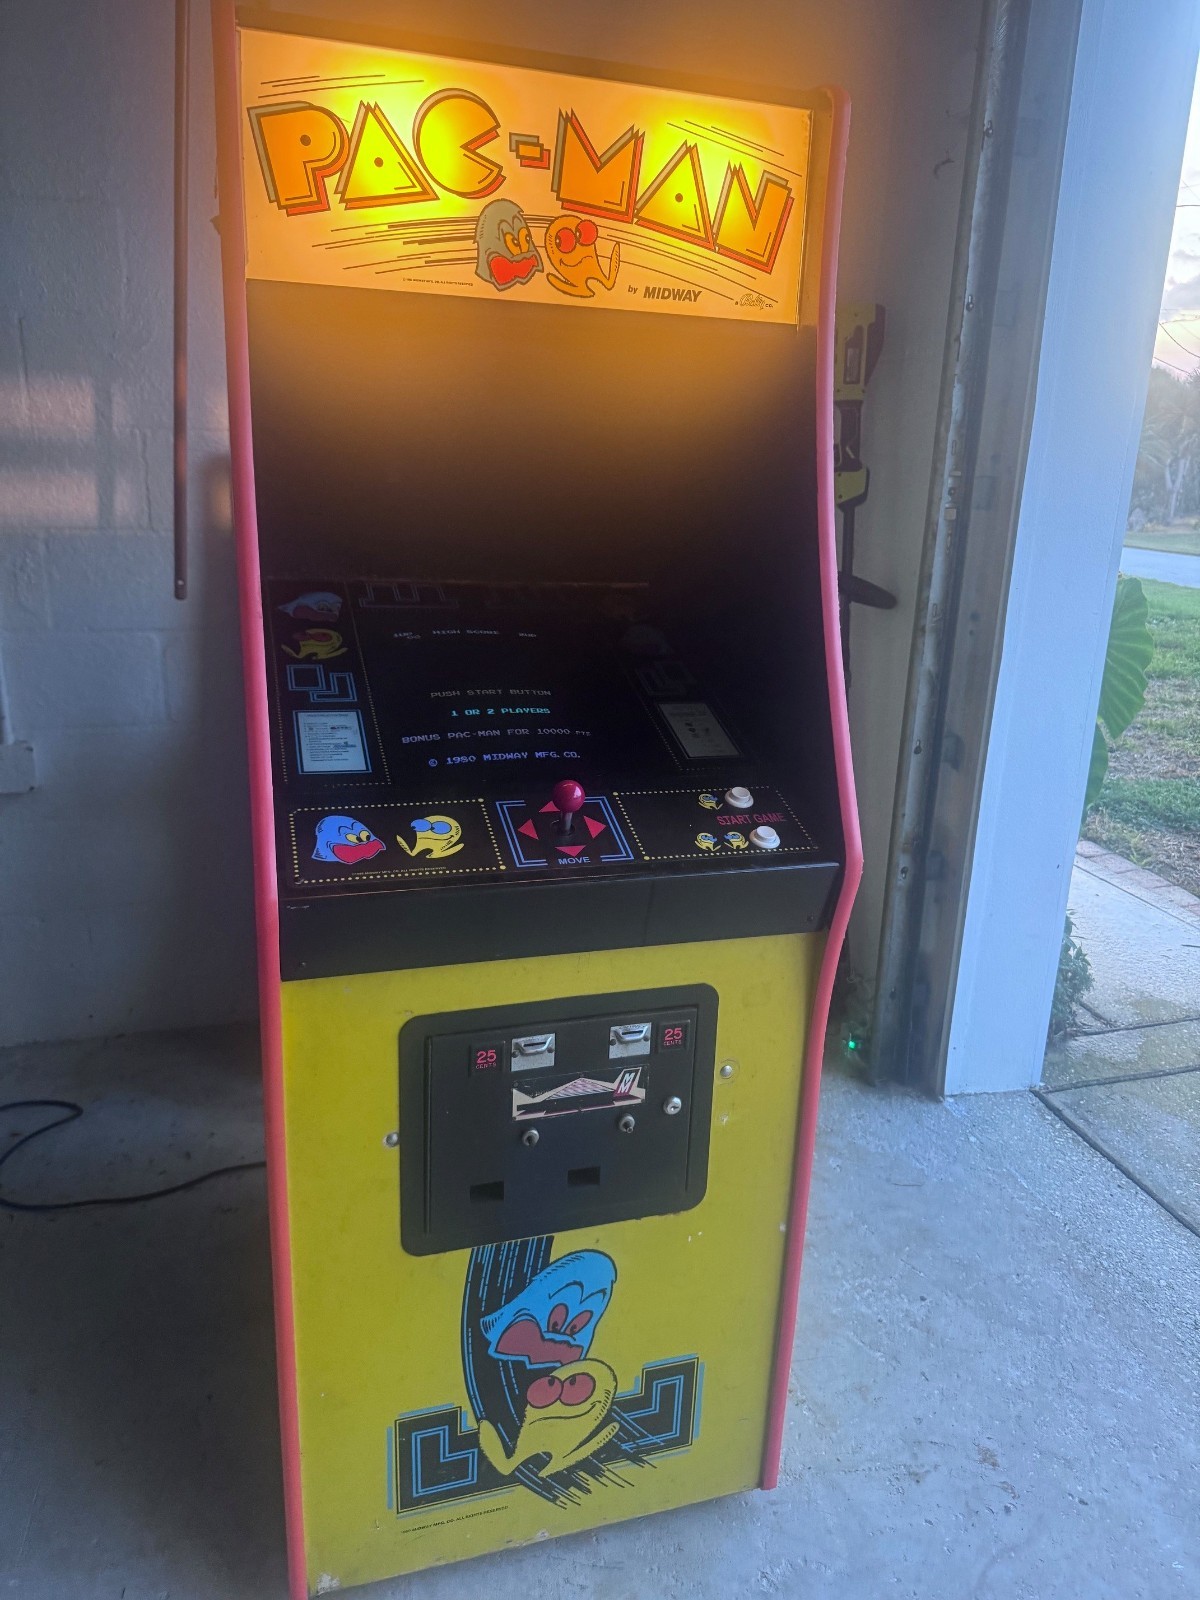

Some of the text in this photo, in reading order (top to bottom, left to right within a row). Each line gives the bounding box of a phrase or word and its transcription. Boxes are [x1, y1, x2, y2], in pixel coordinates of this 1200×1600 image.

[246, 87, 795, 275] PAC-MAN
[627, 285, 702, 303] by MIDWAY
[430, 690, 460, 698] PUSH
[509, 689, 552, 697] BUTTON
[451, 709, 458, 717] 1
[464, 708, 480, 716] OR
[500, 707, 551, 715] PLAYERS
[401, 733, 441, 744] BONUS
[447, 729, 501, 740] PAC-MAN
[507, 728, 530, 736] FOR
[537, 728, 571, 736] 10000
[446, 755, 477, 765] 1980
[483, 751, 528, 761] MIDWAY
[716, 812, 788, 826] START GAME
[557, 855, 591, 865] MOVE
[664, 1027, 683, 1041] 25
[476, 1049, 497, 1064] 25
[475, 1062, 497, 1070] CENTS
